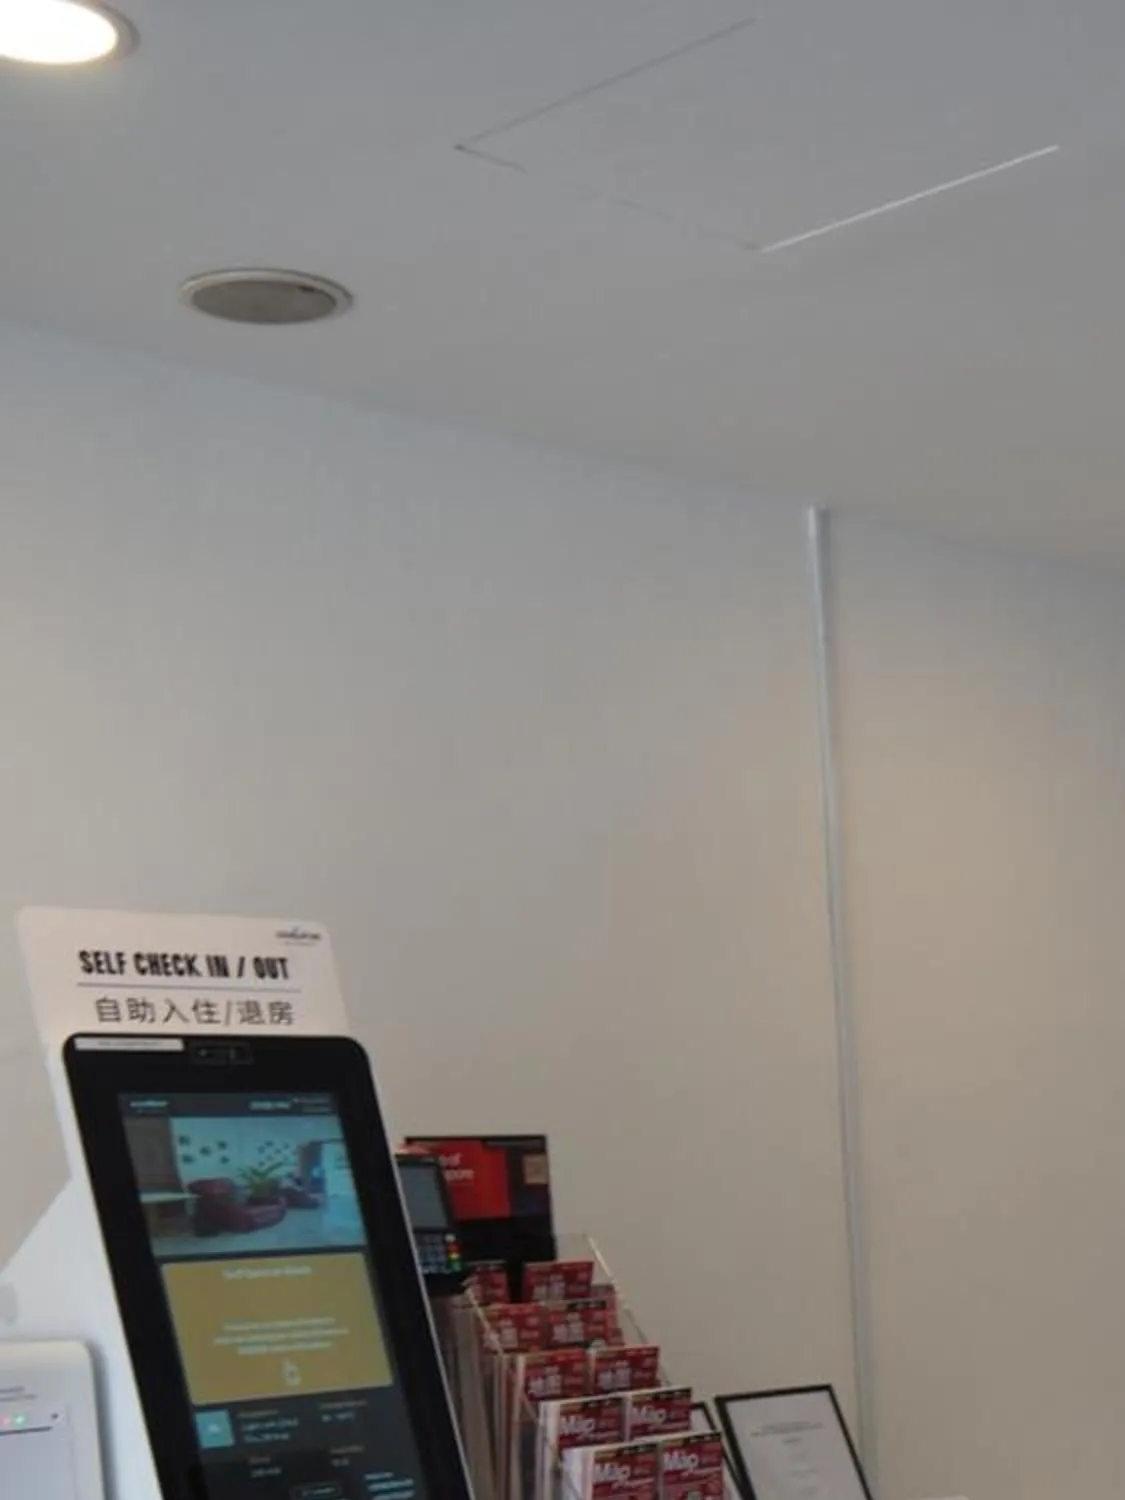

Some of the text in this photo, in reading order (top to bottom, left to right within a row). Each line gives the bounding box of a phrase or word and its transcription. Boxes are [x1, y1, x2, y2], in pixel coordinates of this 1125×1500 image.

[78, 950, 290, 980] SELF CHECK IN / OUT
